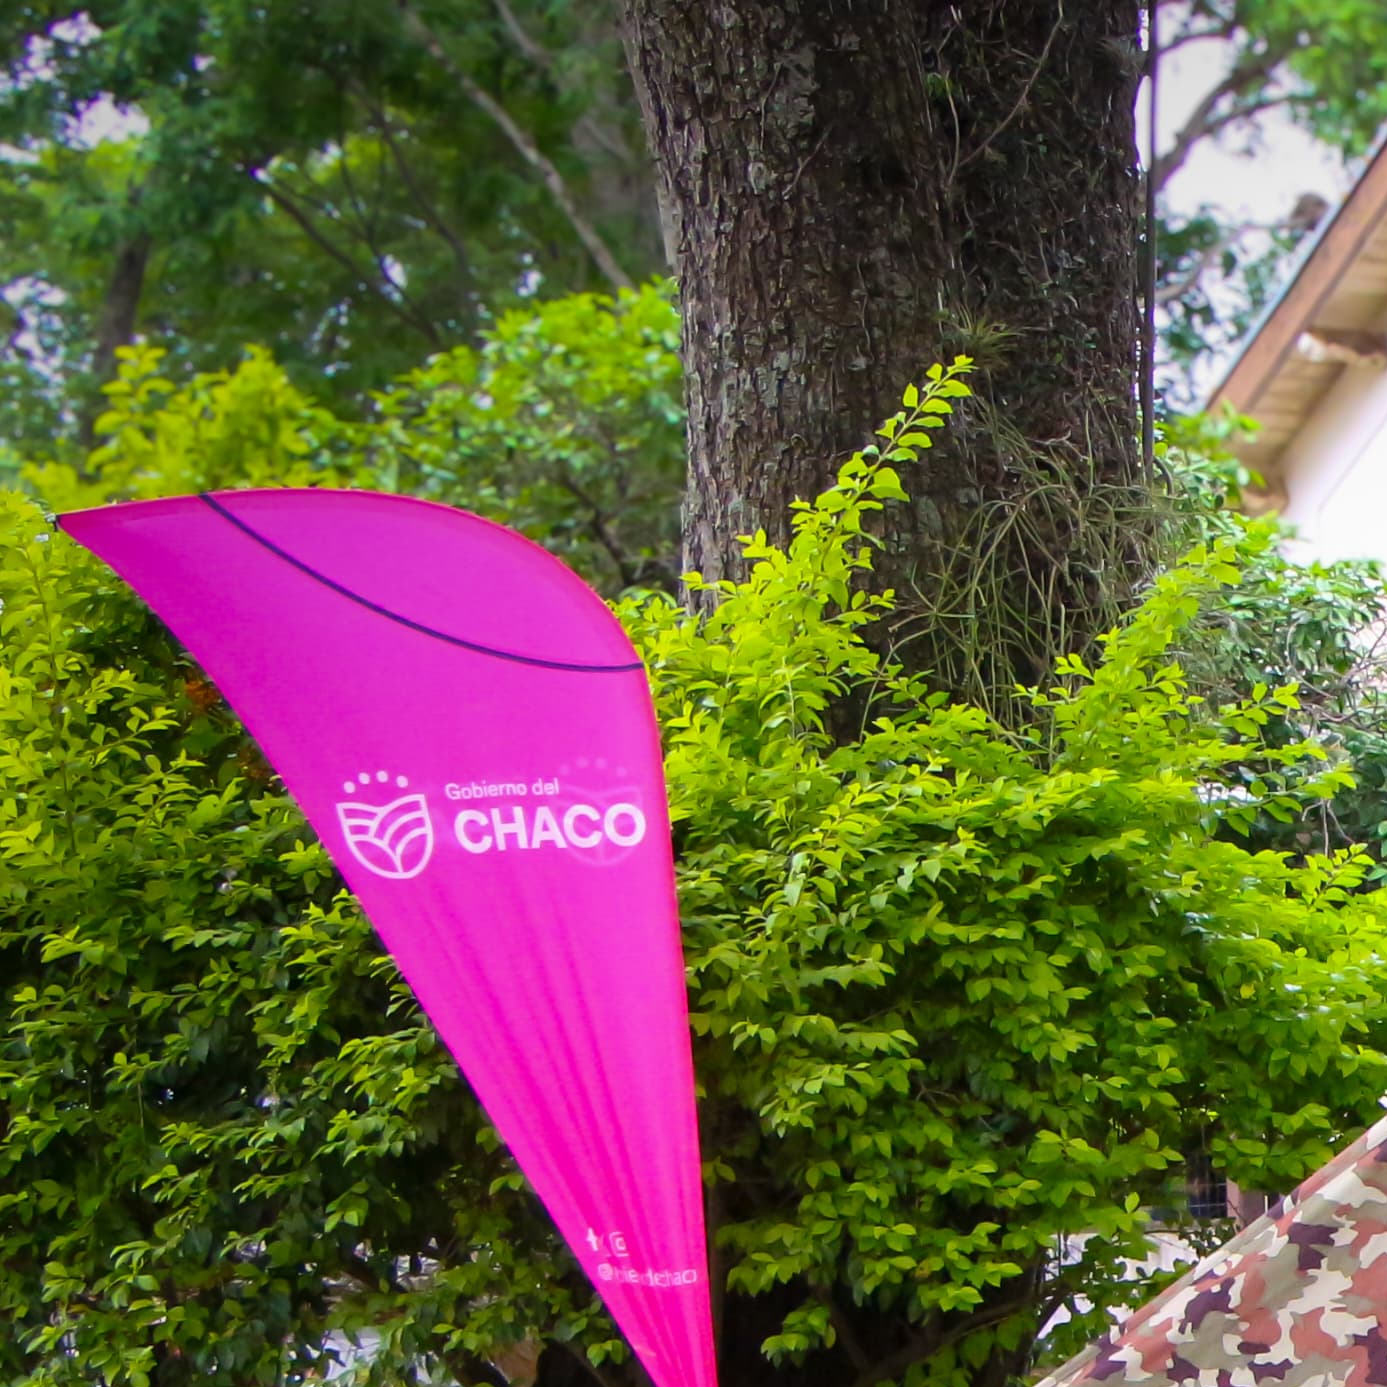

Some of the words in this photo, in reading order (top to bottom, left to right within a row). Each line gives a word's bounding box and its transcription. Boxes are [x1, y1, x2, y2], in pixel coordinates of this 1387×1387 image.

[445, 780, 527, 801] Gobierno
[532, 778, 560, 796] del
[454, 803, 646, 854] CHACO
